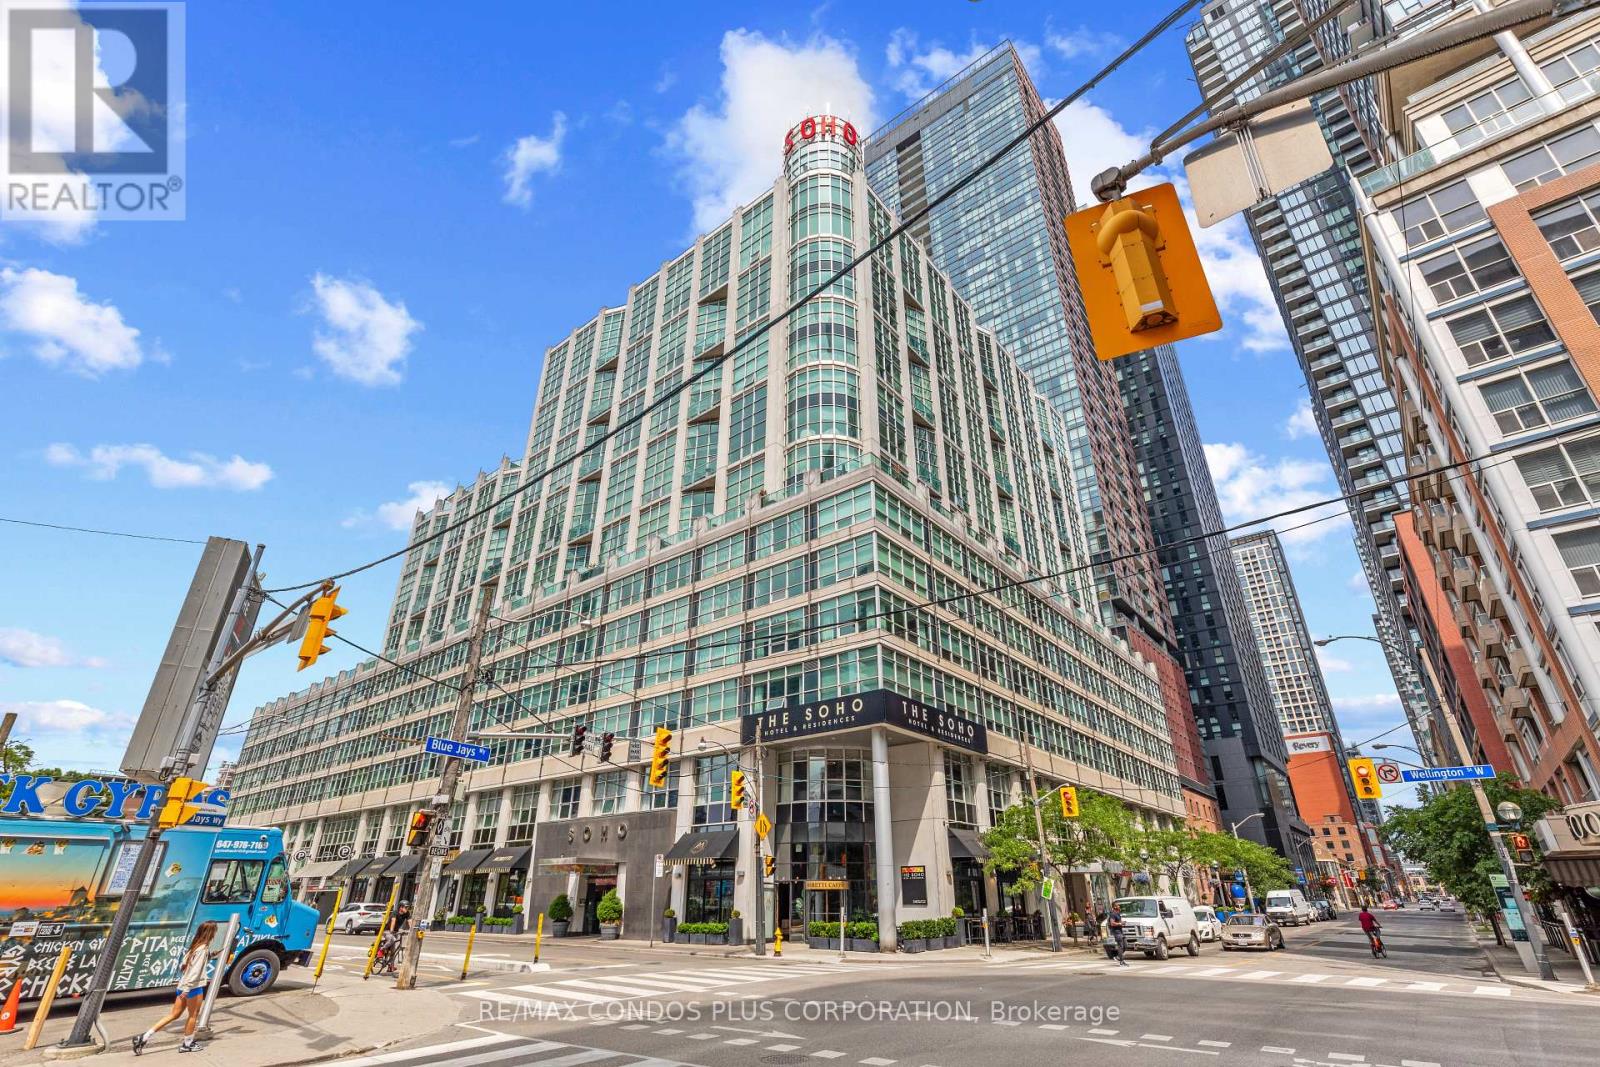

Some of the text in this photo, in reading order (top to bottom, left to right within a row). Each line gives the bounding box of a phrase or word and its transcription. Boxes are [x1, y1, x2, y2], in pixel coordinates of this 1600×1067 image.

[757, 698, 863, 730] THE SOHO
[902, 701, 974, 737] THE SOHO
[764, 728, 789, 736] HOTEL
[802, 715, 855, 730] RESIDENCES
[908, 718, 928, 730] HOTEL
[937, 728, 971, 745] RESIDENCES
[431, 739, 453, 753] Blue
[455, 745, 476, 757] Jays
[1410, 768, 1464, 779] Wellington
[1474, 766, 1484, 776] W
[63, 780, 231, 819] GYRS
[567, 823, 628, 845] SOHO
[130, 936, 168, 953] PITA
